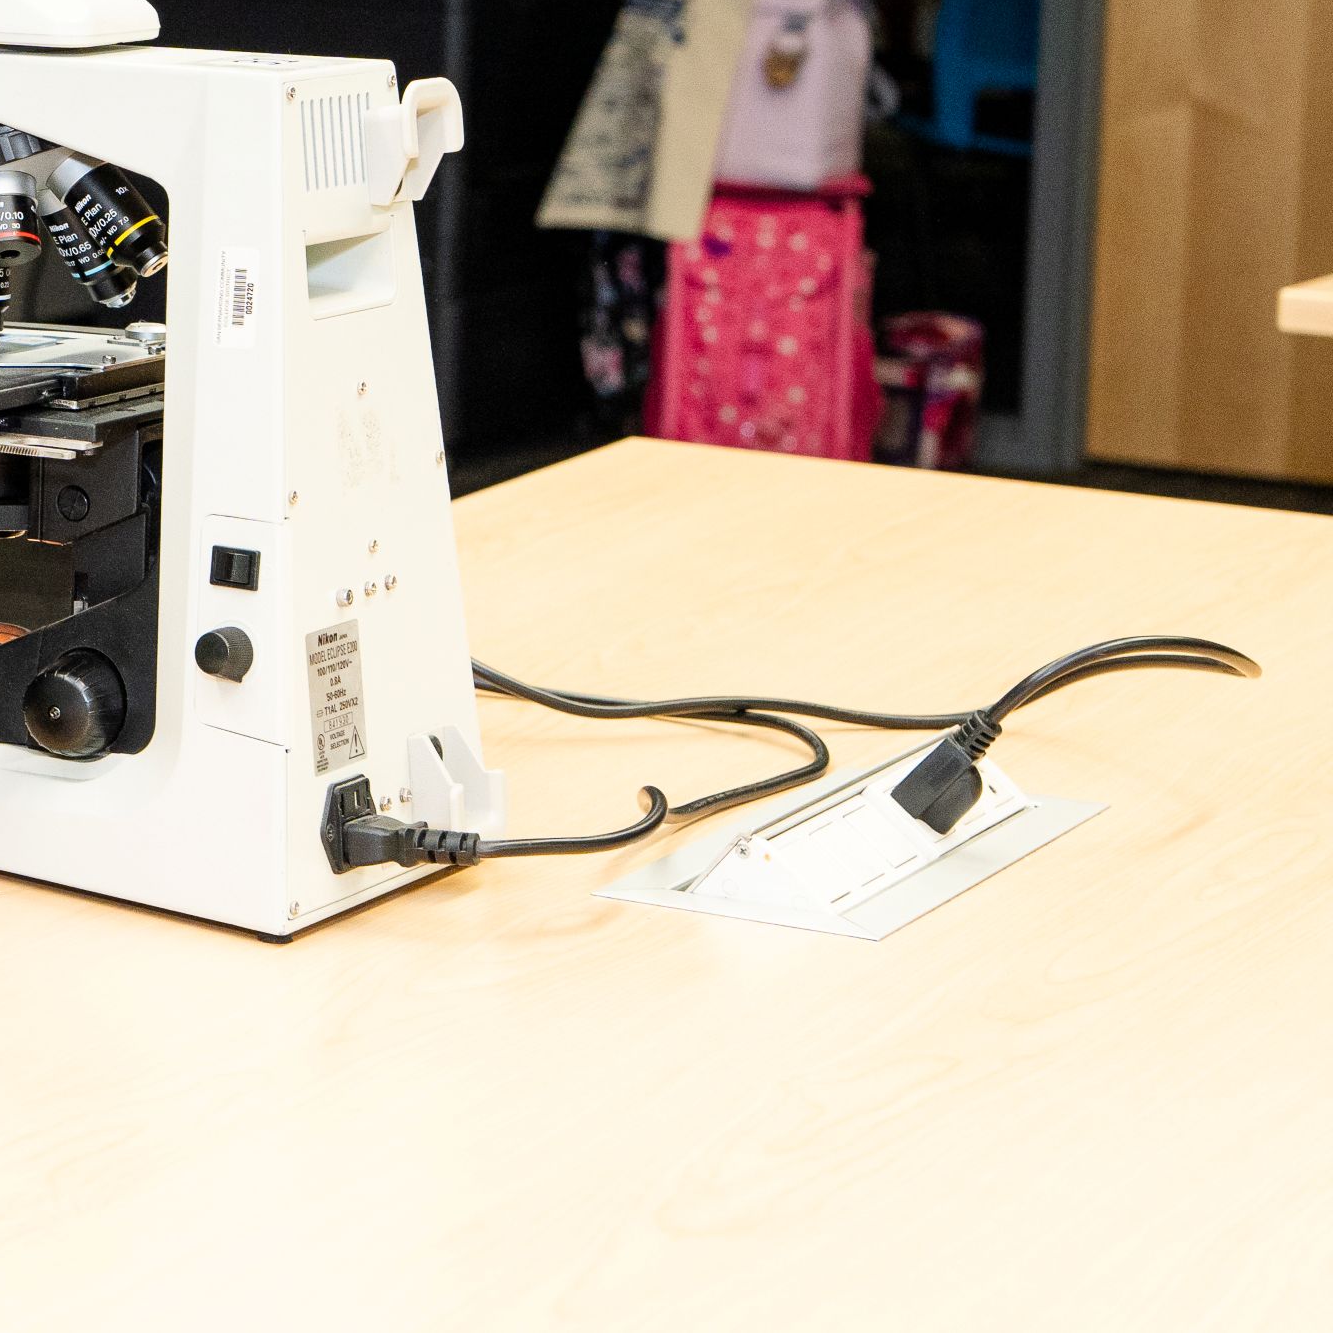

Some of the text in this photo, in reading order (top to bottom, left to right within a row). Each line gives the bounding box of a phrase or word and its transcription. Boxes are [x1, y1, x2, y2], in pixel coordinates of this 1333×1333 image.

[75, 194, 92, 213] Nikon
[84, 203, 102, 221] Plan
[49, 222, 69, 233] Nikon
[107, 225, 118, 236] WD
[118, 216, 130, 225] 7.0
[58, 233, 78, 244] Plan
[78, 256, 90, 265] WD
[246, 282, 254, 315] 0024720
[318, 633, 337, 647] Nikon
[309, 640, 357, 666] MODEL ECLIPSE E200
[329, 730, 345, 740] VOLTAGE
[330, 738, 349, 750] SELECTION
